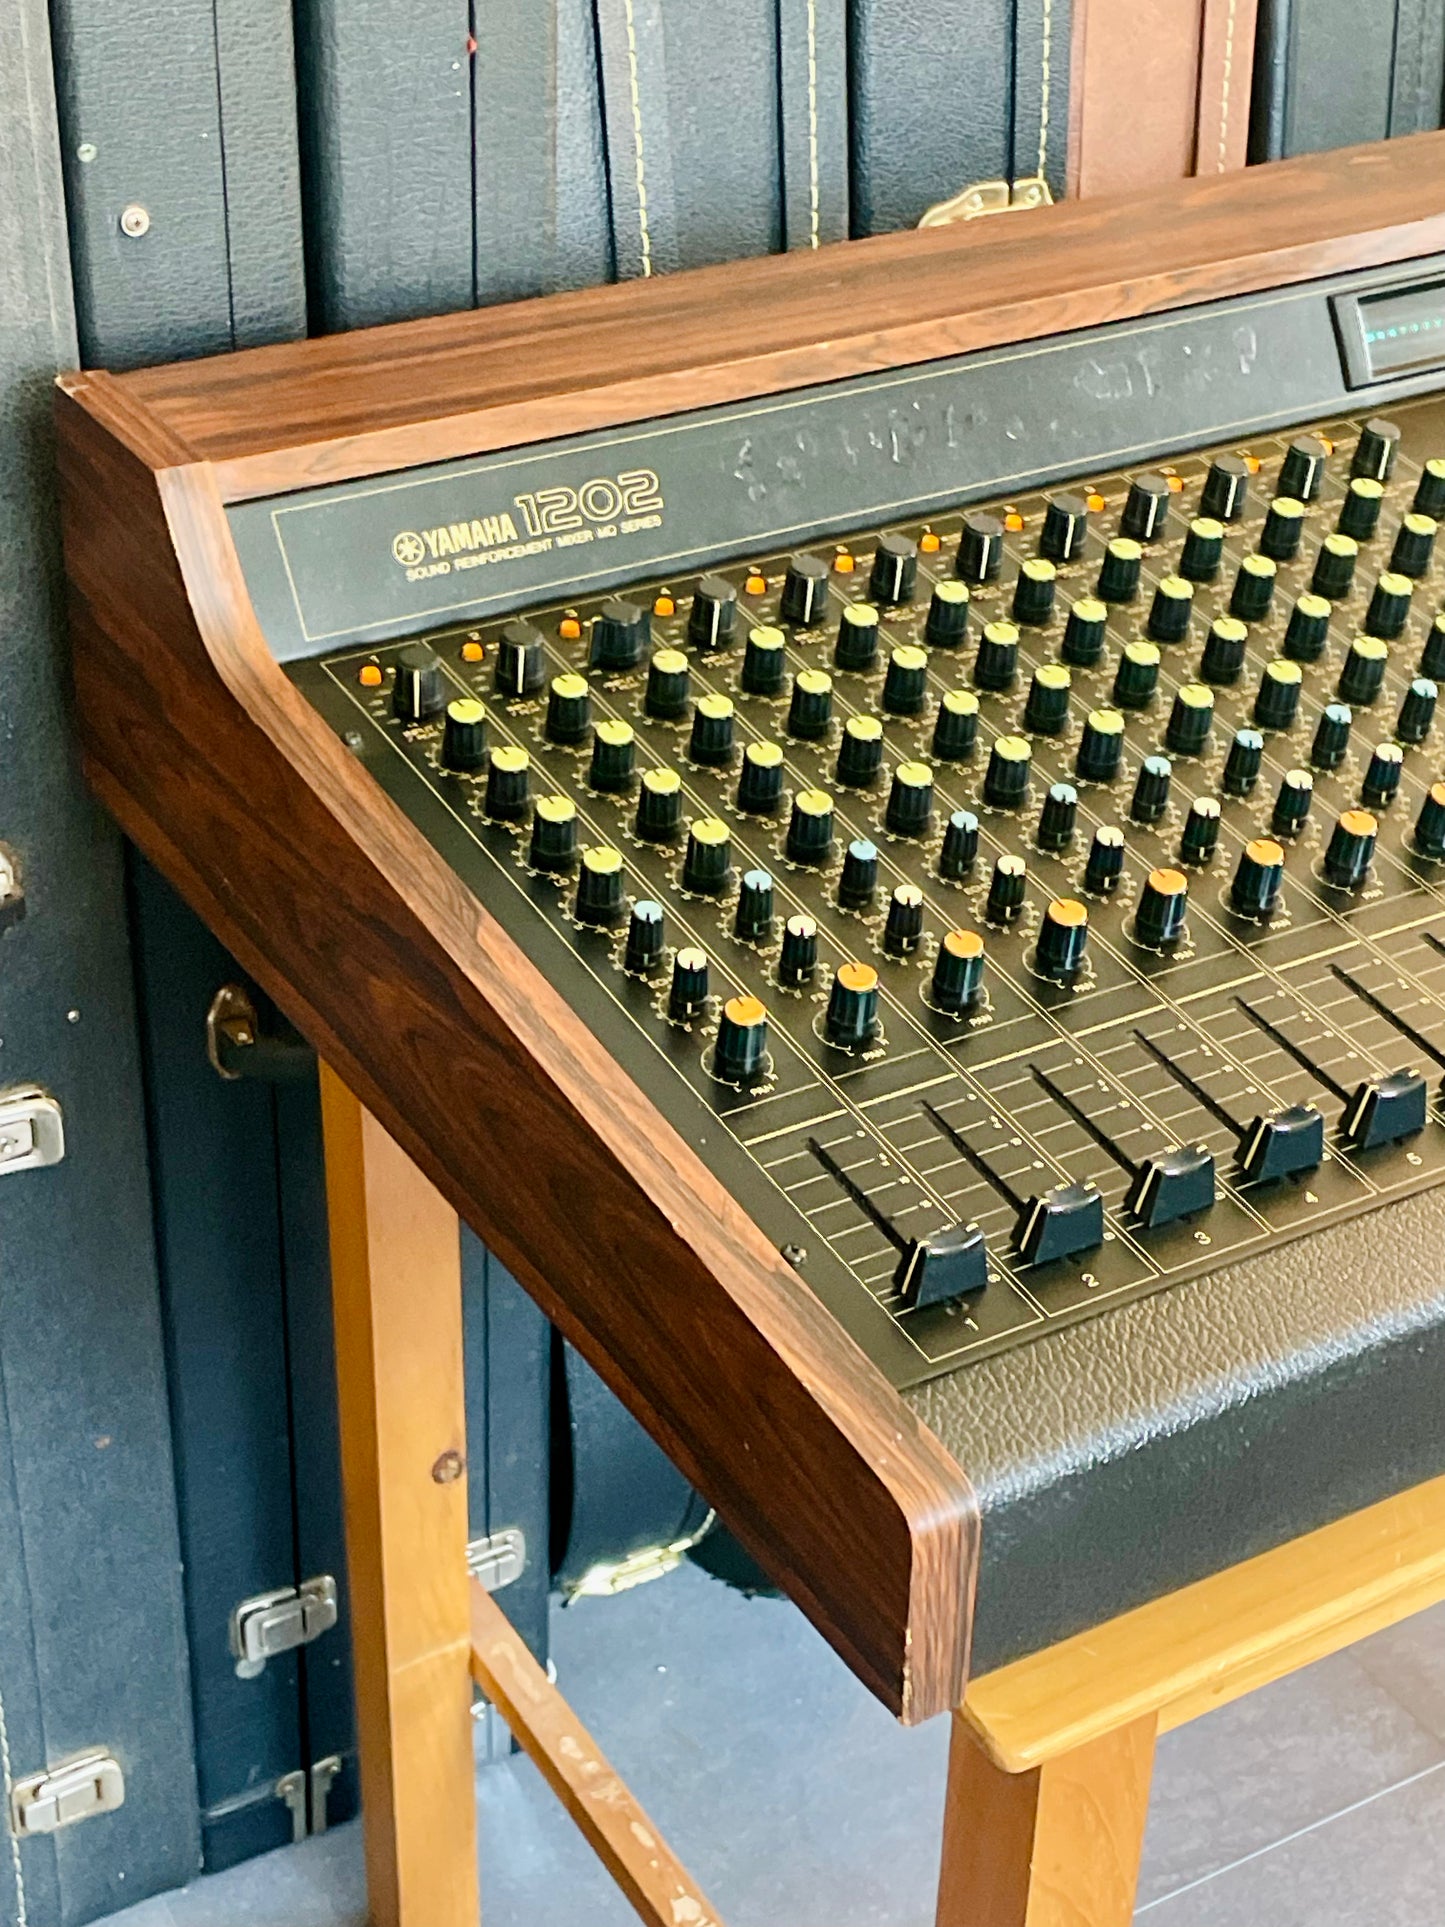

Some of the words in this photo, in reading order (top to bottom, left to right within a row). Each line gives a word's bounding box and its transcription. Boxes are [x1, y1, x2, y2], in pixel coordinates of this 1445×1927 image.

[422, 513, 519, 558] YAMAHA
[514, 469, 664, 537] 1202
[404, 562, 452, 582] SOUND
[454, 538, 553, 571] REINFORCEMENT
[556, 529, 594, 548] MIXER
[620, 515, 663, 534] SERIES
[1193, 1230, 1212, 1245] 3
[1081, 1273, 1100, 1288] 2
[964, 1317, 980, 1332] 1
